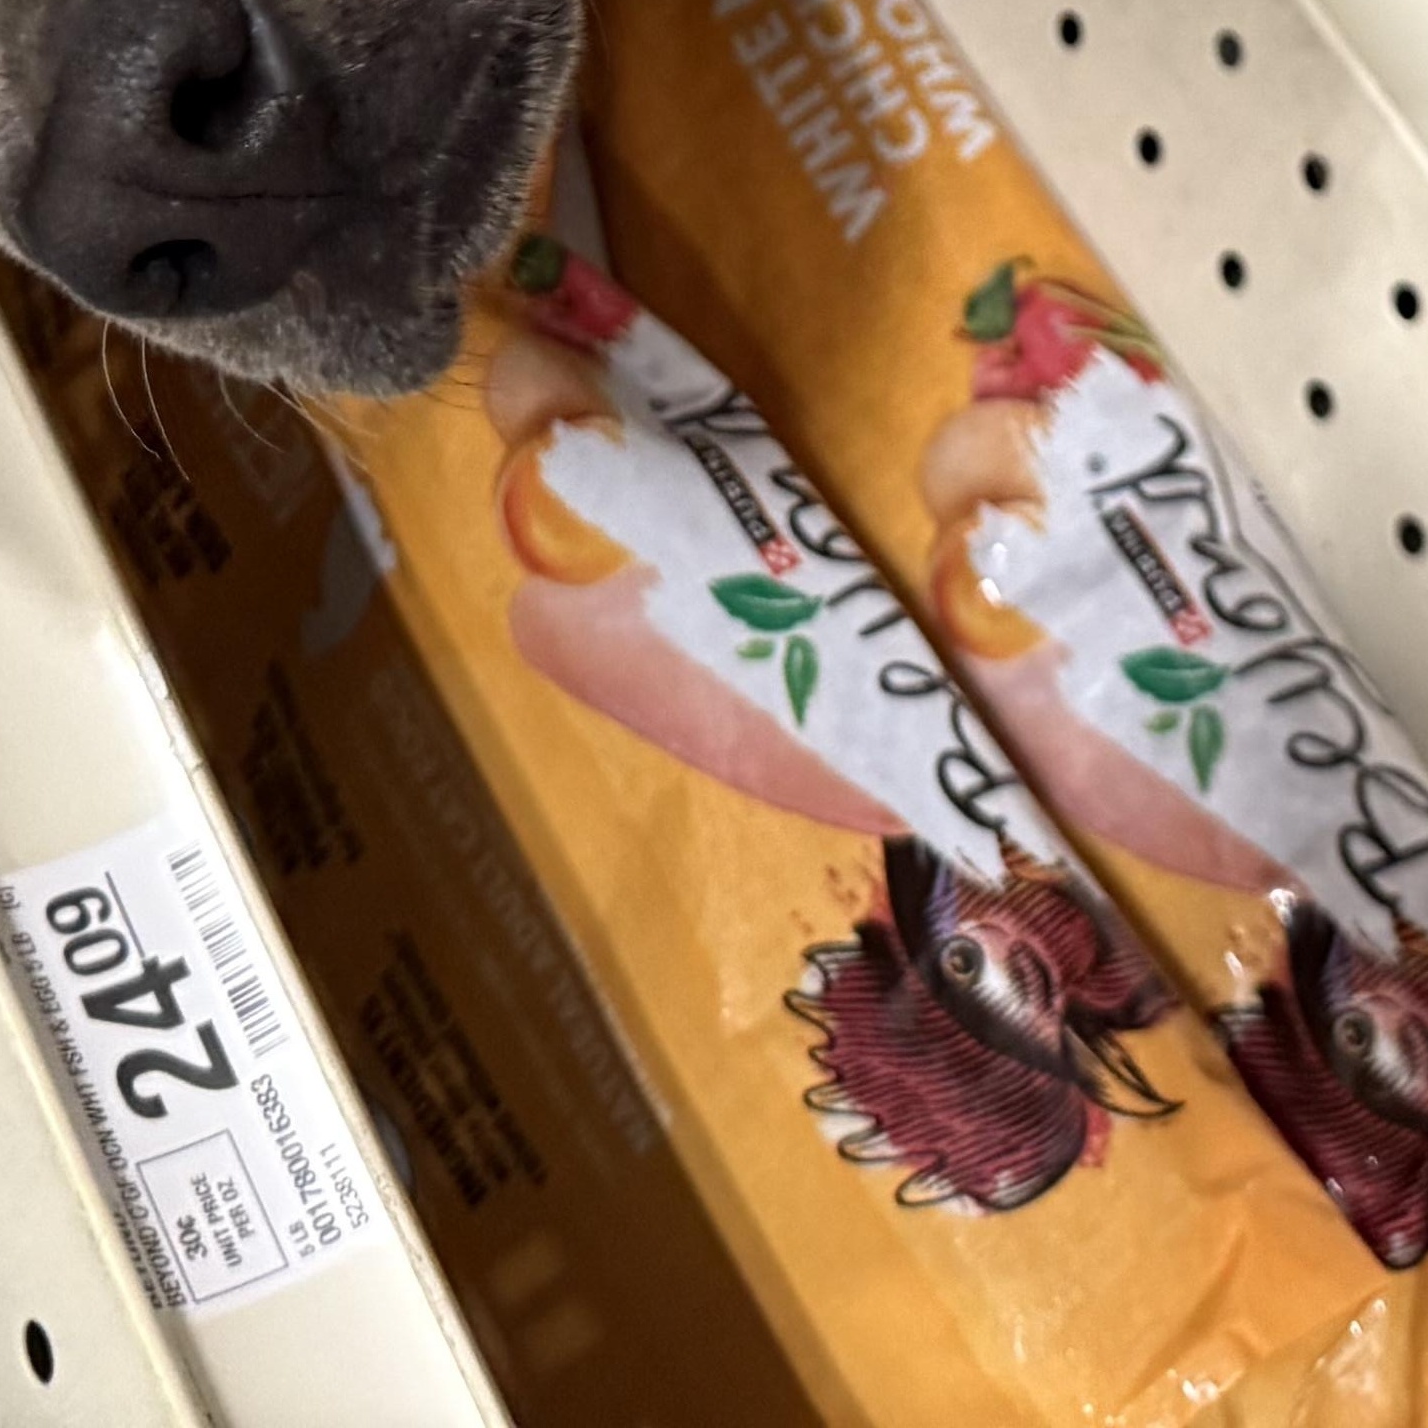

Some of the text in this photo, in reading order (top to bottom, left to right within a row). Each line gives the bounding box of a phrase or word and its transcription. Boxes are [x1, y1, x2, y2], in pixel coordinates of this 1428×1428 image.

[727, 8, 889, 245] WHITE
[10, 931, 39, 957] LB
[29, 977, 62, 1015] EGG
[53, 1035, 88, 1076] FSH
[73, 1081, 109, 1124] WHT
[92, 1127, 128, 1172] OCN
[249, 1072, 343, 1246] 001780016383
[215, 1175, 257, 1239] PER OZ
[317, 1141, 371, 1229] 5238111
[173, 1212, 209, 1262] 30¢
[188, 1170, 244, 1268] UNIT PRICE
[287, 1218, 310, 1243] LB
[134, 1224, 187, 1310] BEYOND
